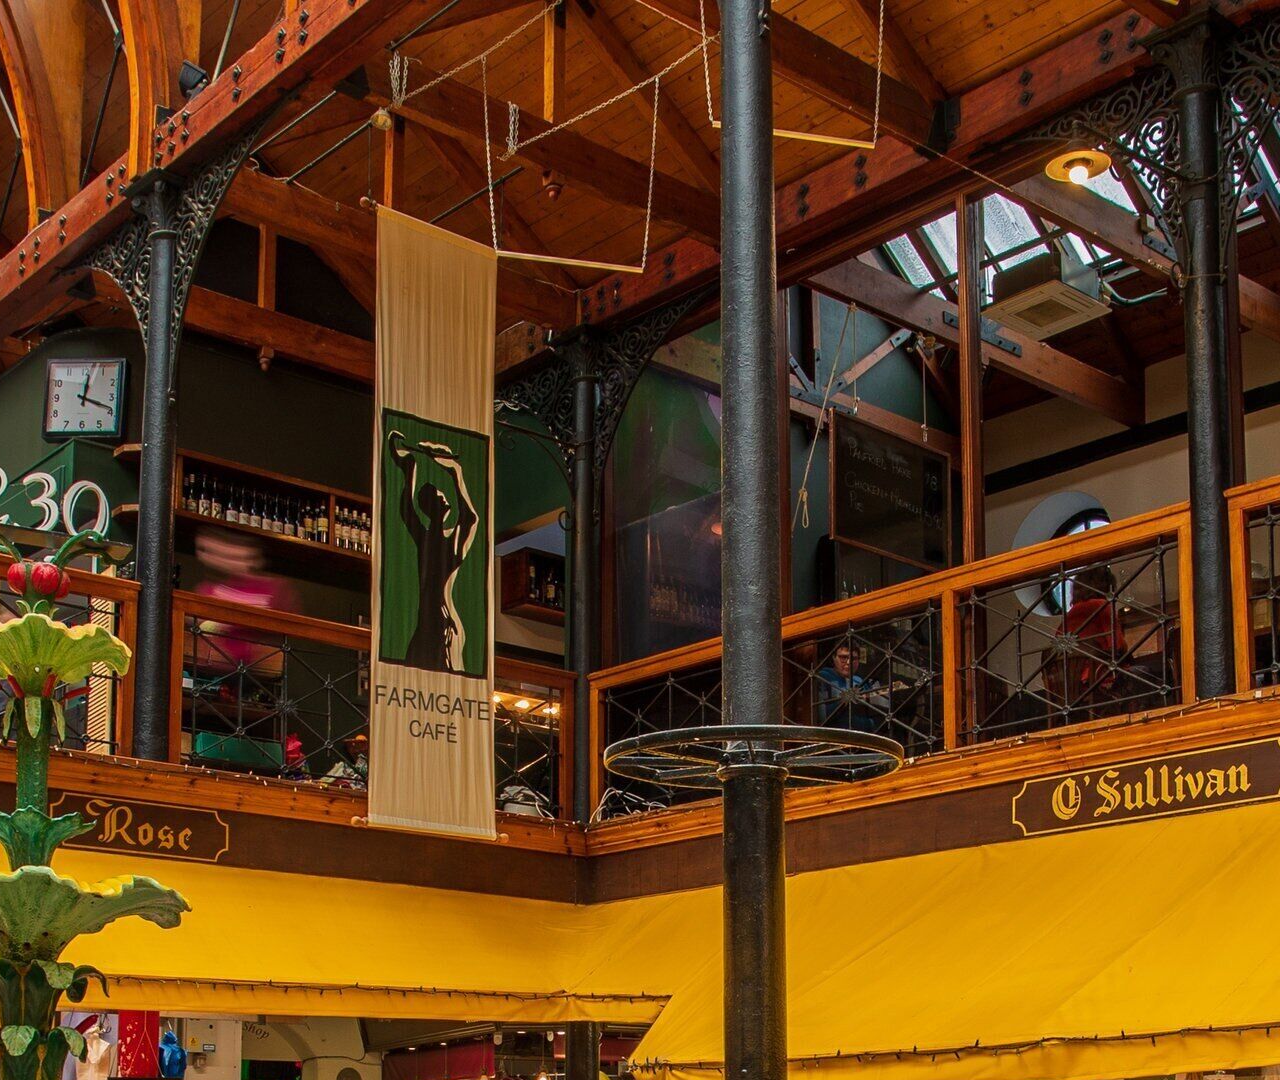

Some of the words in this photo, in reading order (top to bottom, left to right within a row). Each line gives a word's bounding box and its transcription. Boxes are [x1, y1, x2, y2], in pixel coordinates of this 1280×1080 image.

[54, 380, 63, 388] 10
[110, 379, 115, 387] 2
[54, 394, 60, 403] 9
[109, 393, 114, 401] 3
[53, 410, 58, 418] 8
[64, 421, 69, 429] 7
[79, 421, 85, 429] 6
[96, 420, 102, 428] 5
[375, 684, 490, 721] FARMGATE
[409, 719, 458, 744] CAFÉ
[1051, 763, 1251, 821] O'Sullivan
[85, 800, 193, 851] Rose
